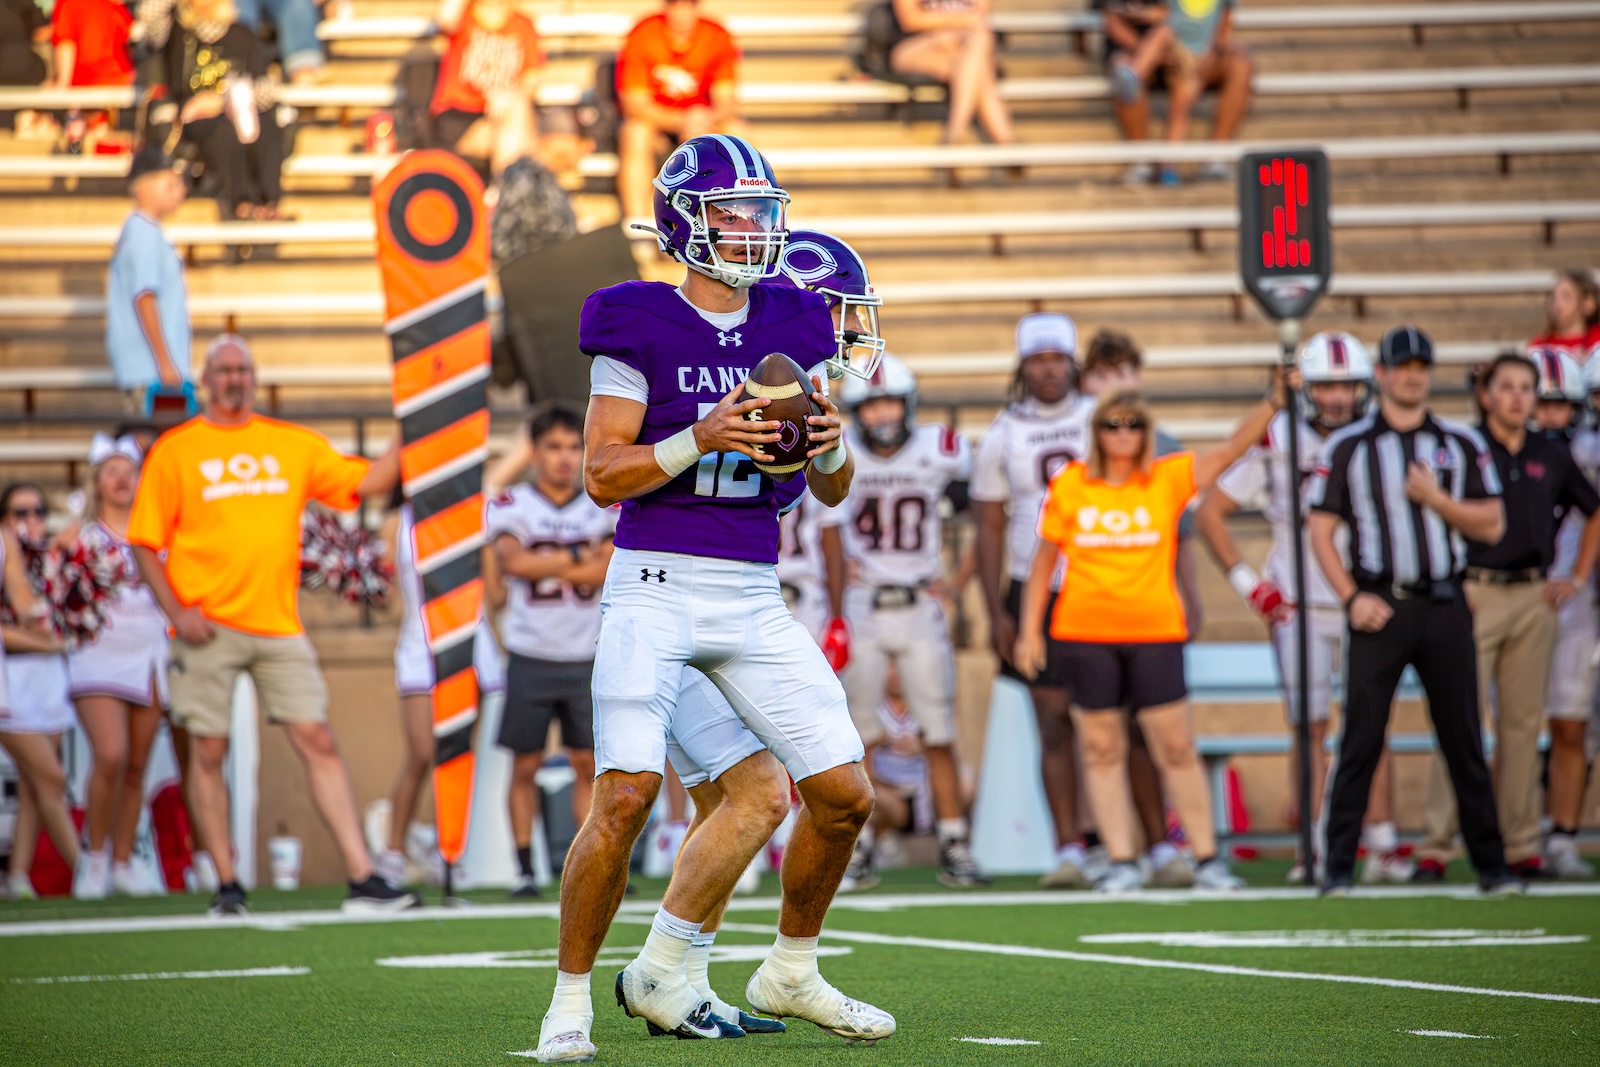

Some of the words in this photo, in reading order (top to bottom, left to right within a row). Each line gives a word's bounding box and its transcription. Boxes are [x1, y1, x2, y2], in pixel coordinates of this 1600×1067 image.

[739, 178, 769, 187] Riddell
[1259, 157, 1311, 268] 2
[677, 366, 751, 393] CANY
[856, 494, 925, 551] 40
